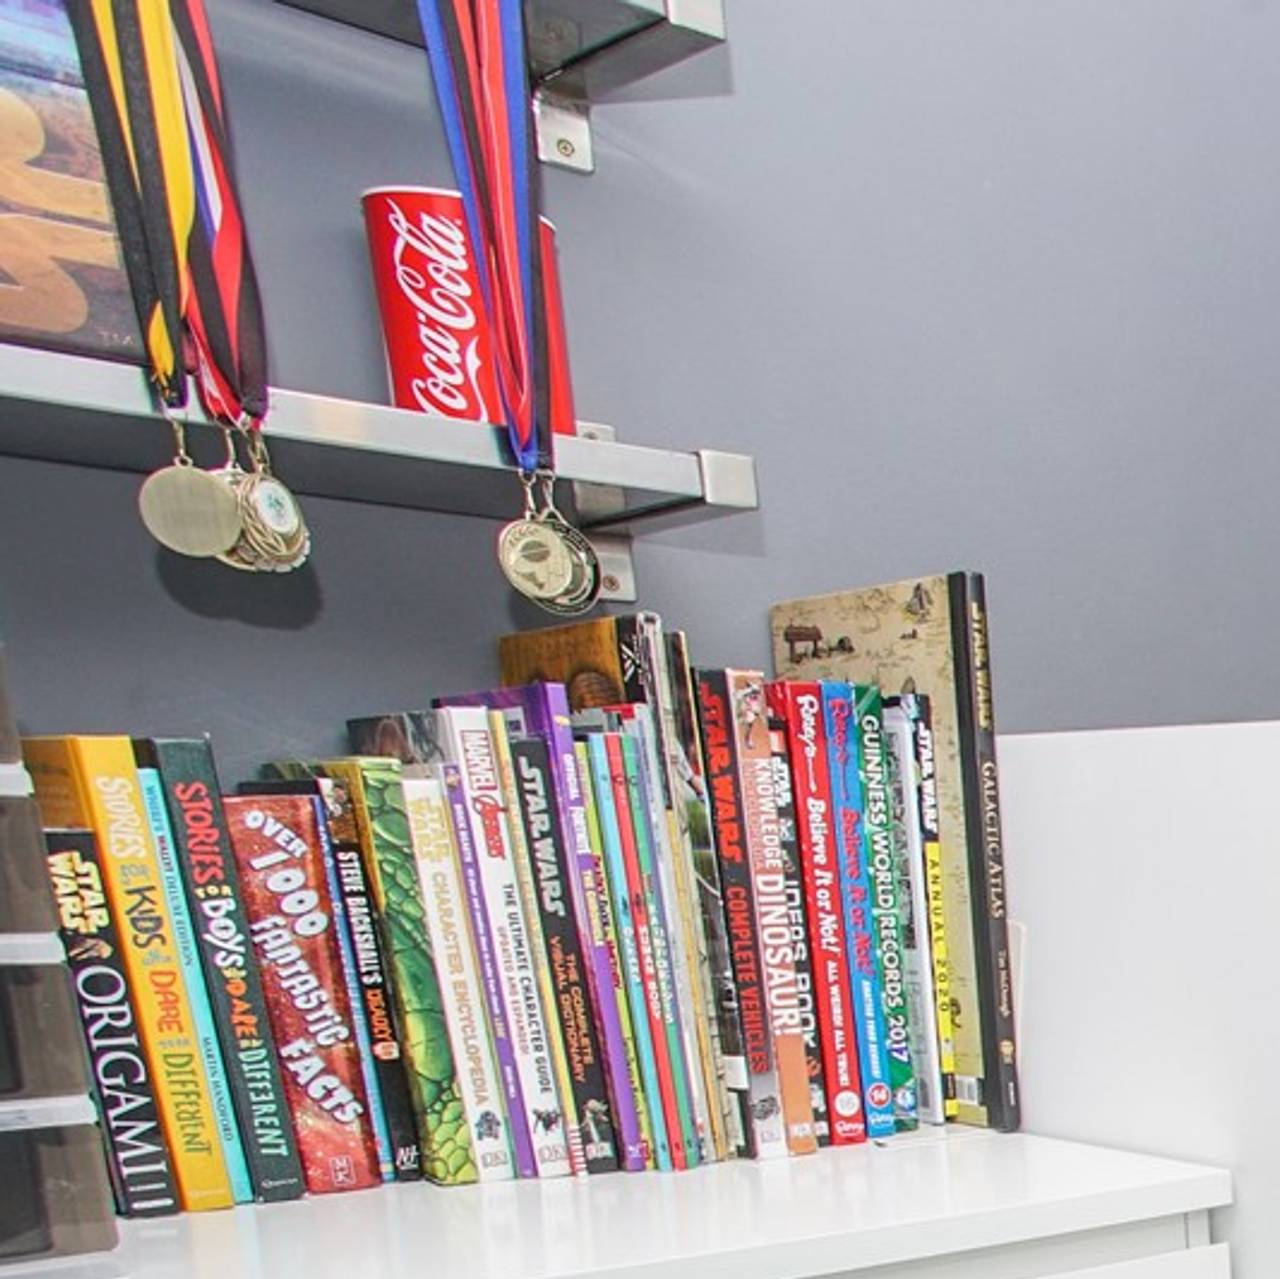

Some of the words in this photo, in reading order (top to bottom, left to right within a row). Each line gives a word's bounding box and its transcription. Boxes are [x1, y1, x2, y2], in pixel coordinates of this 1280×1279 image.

[460, 729, 498, 792] MARVEL
[700, 680, 731, 773] STAR
[918, 721, 935, 779] STAR
[861, 715, 888, 825] GUINNESS
[921, 779, 938, 834] WARS
[982, 762, 1001, 858] GALACTIC
[95, 776, 146, 859] STORIES
[174, 781, 225, 884] STORIES
[243, 809, 309, 859] OVER
[517, 754, 549, 838] STAR
[537, 838, 566, 918] WARS
[710, 776, 742, 864] WARS
[754, 758, 783, 870] KNOWLEDGE
[807, 796, 829, 865] Believe
[841, 807, 861, 880] Believe
[47, 852, 88, 934] WARS
[73, 850, 111, 934] STAR
[250, 850, 329, 937] 1000
[337, 851, 365, 892] STEVE
[502, 883, 515, 907] THE
[814, 868, 833, 886] It
[815, 887, 832, 910] or
[849, 885, 868, 903] It
[870, 830, 896, 910] WORLD
[928, 859, 945, 942] ANNUAL
[988, 862, 1005, 919] ATLAS
[125, 885, 167, 949] KIDS
[201, 897, 247, 968] BOYS
[345, 896, 383, 985] BACKSHALL'S
[508, 911, 530, 977] ULTIMATE
[726, 886, 757, 984] COMPLETE
[756, 873, 802, 1036] DINOSAUR!
[816, 909, 843, 955] Not!
[851, 906, 868, 929] or
[251, 914, 350, 1047] FANTASTIC
[431, 871, 465, 981] CHARACTER
[452, 980, 491, 1107] ENCYCLOPEDIA
[550, 935, 569, 990] VISUAL
[564, 953, 581, 981] THE
[879, 914, 904, 1008] RECORDS
[936, 959, 949, 1013] 2020
[150, 970, 184, 1034] DARE
[226, 978, 259, 1038] DARE
[366, 988, 393, 1042] DEADLY
[519, 977, 544, 1057] CHARACTER
[559, 992, 587, 1084] DICTIONARY
[571, 986, 595, 1065] COMPLETE
[740, 986, 769, 1075] VEHICLES
[827, 961, 839, 985] ALL
[834, 1030, 848, 1053] ALL
[888, 1016, 909, 1063] 2017
[75, 964, 168, 1183] ORIGAMI
[162, 1053, 213, 1155] DIFFERENT
[238, 1047, 290, 1157] DIFFERENT
[280, 1037, 364, 1124] FACTS
[534, 1057, 552, 1094] GUIDE
